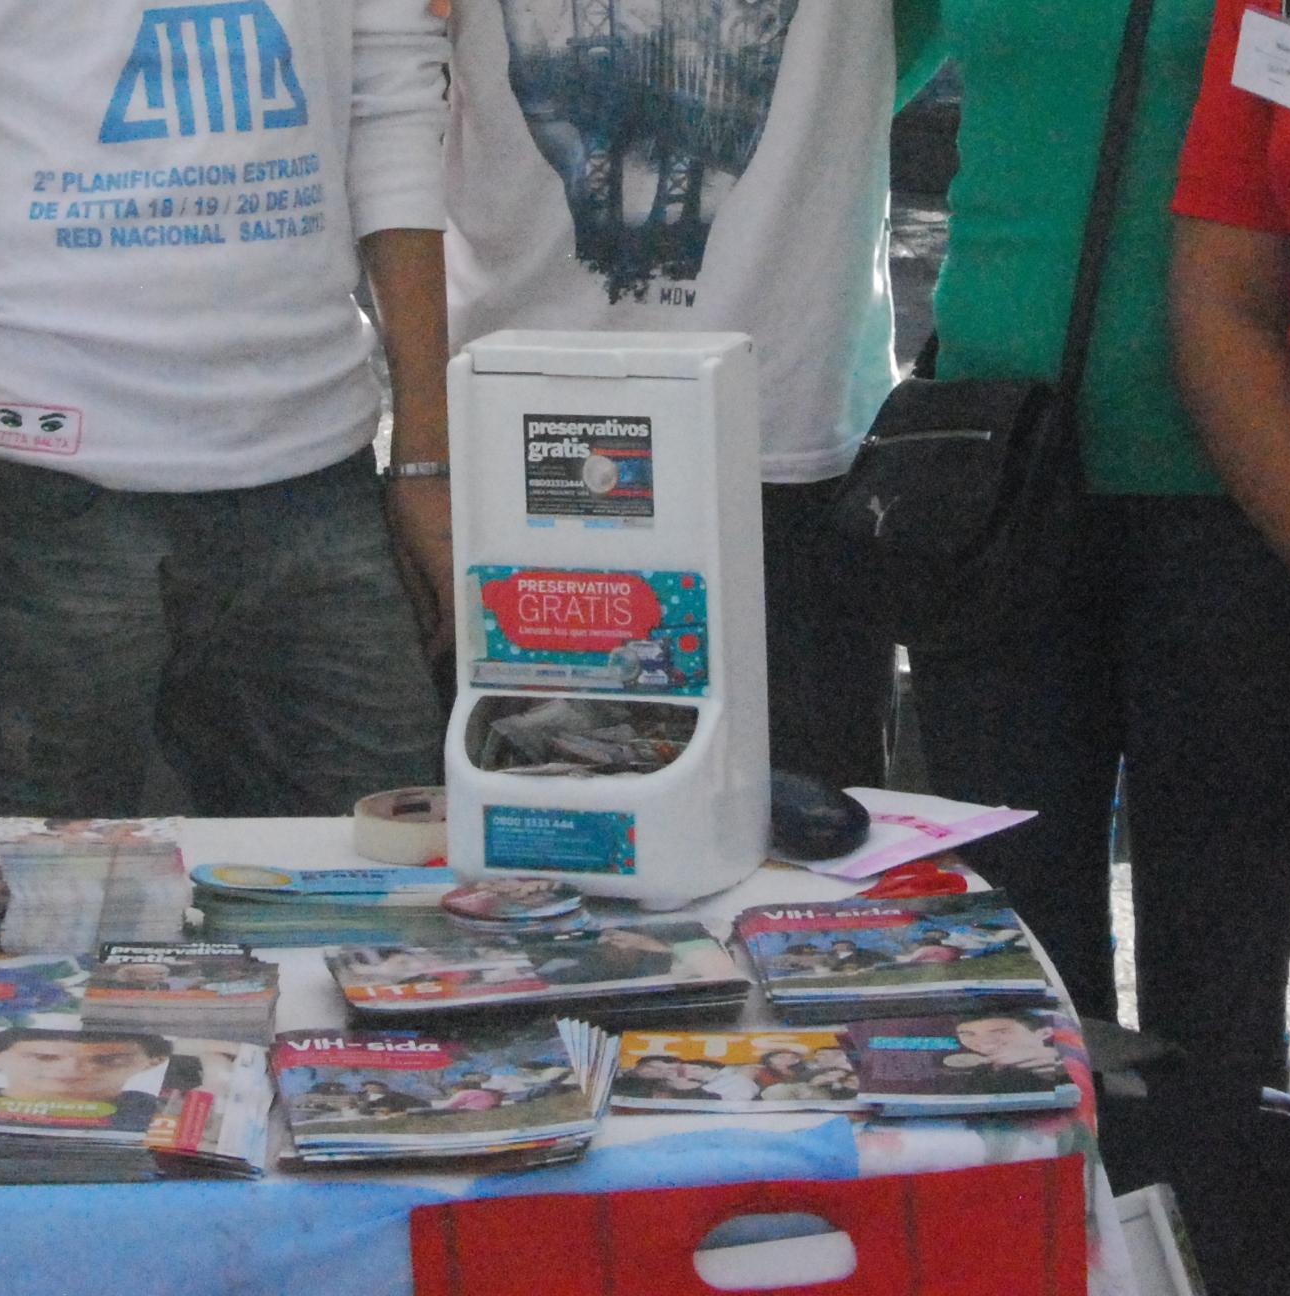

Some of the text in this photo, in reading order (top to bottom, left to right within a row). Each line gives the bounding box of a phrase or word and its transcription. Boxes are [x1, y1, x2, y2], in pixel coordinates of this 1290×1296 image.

[62, 163, 237, 193] PLANIFICACION
[29, 201, 58, 220] DE
[149, 197, 174, 218] 18
[194, 196, 219, 216] 19
[235, 193, 260, 216] 20
[266, 189, 289, 211] DE
[56, 226, 102, 249] RED
[110, 223, 227, 247] NACIONAL
[239, 217, 297, 242] SALTA
[528, 418, 649, 438] preservativos
[528, 437, 590, 462] gratis
[518, 579, 631, 595] PRESERVATIVO
[518, 594, 632, 626] GRATIS
[366, 981, 443, 997] ITS
[288, 1037, 442, 1052] VIH-sida
[628, 1034, 810, 1057] ITS
